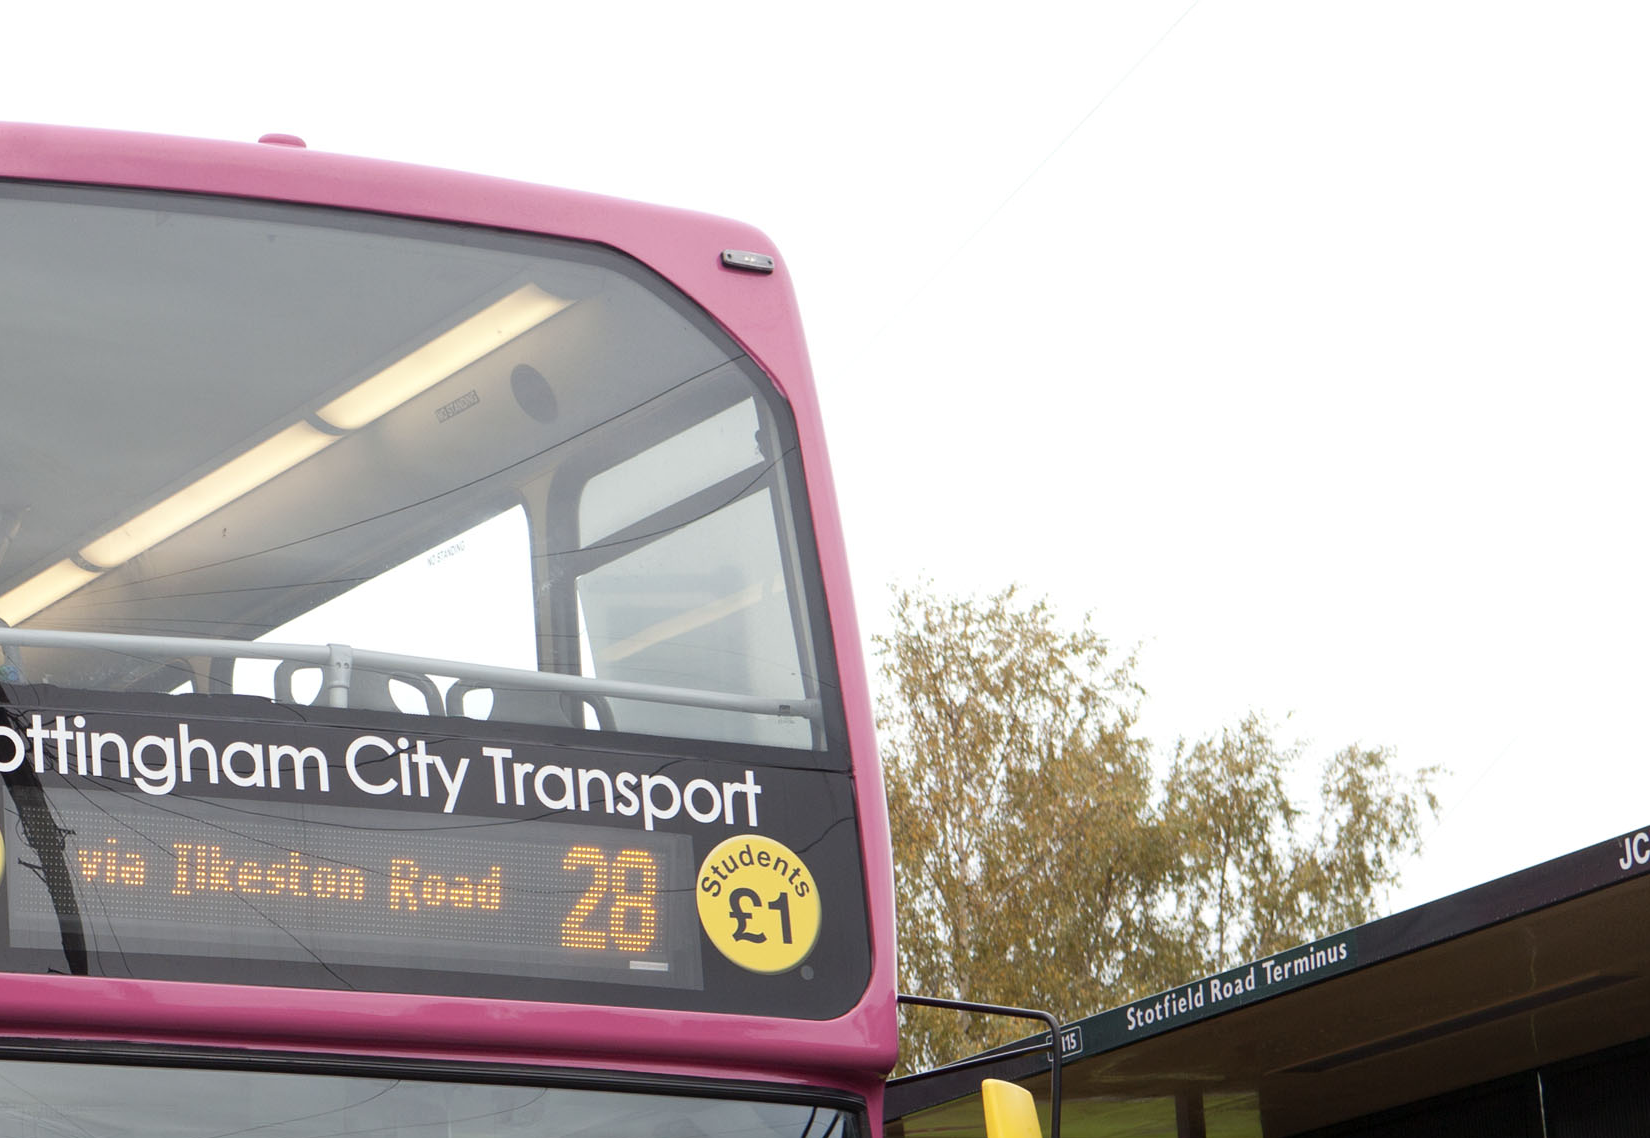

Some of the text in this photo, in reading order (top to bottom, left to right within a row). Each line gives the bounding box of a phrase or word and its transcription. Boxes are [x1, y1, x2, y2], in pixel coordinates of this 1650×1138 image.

[344, 734, 471, 814] City
[482, 746, 762, 832] Transport
[78, 837, 657, 952] via Ilkeston Road 28
[701, 844, 810, 898] Students
[728, 887, 793, 945] £1
[1126, 983, 1204, 1031] Stotfield
[1209, 966, 1255, 1003] Road
[1262, 942, 1348, 985] Terminus
